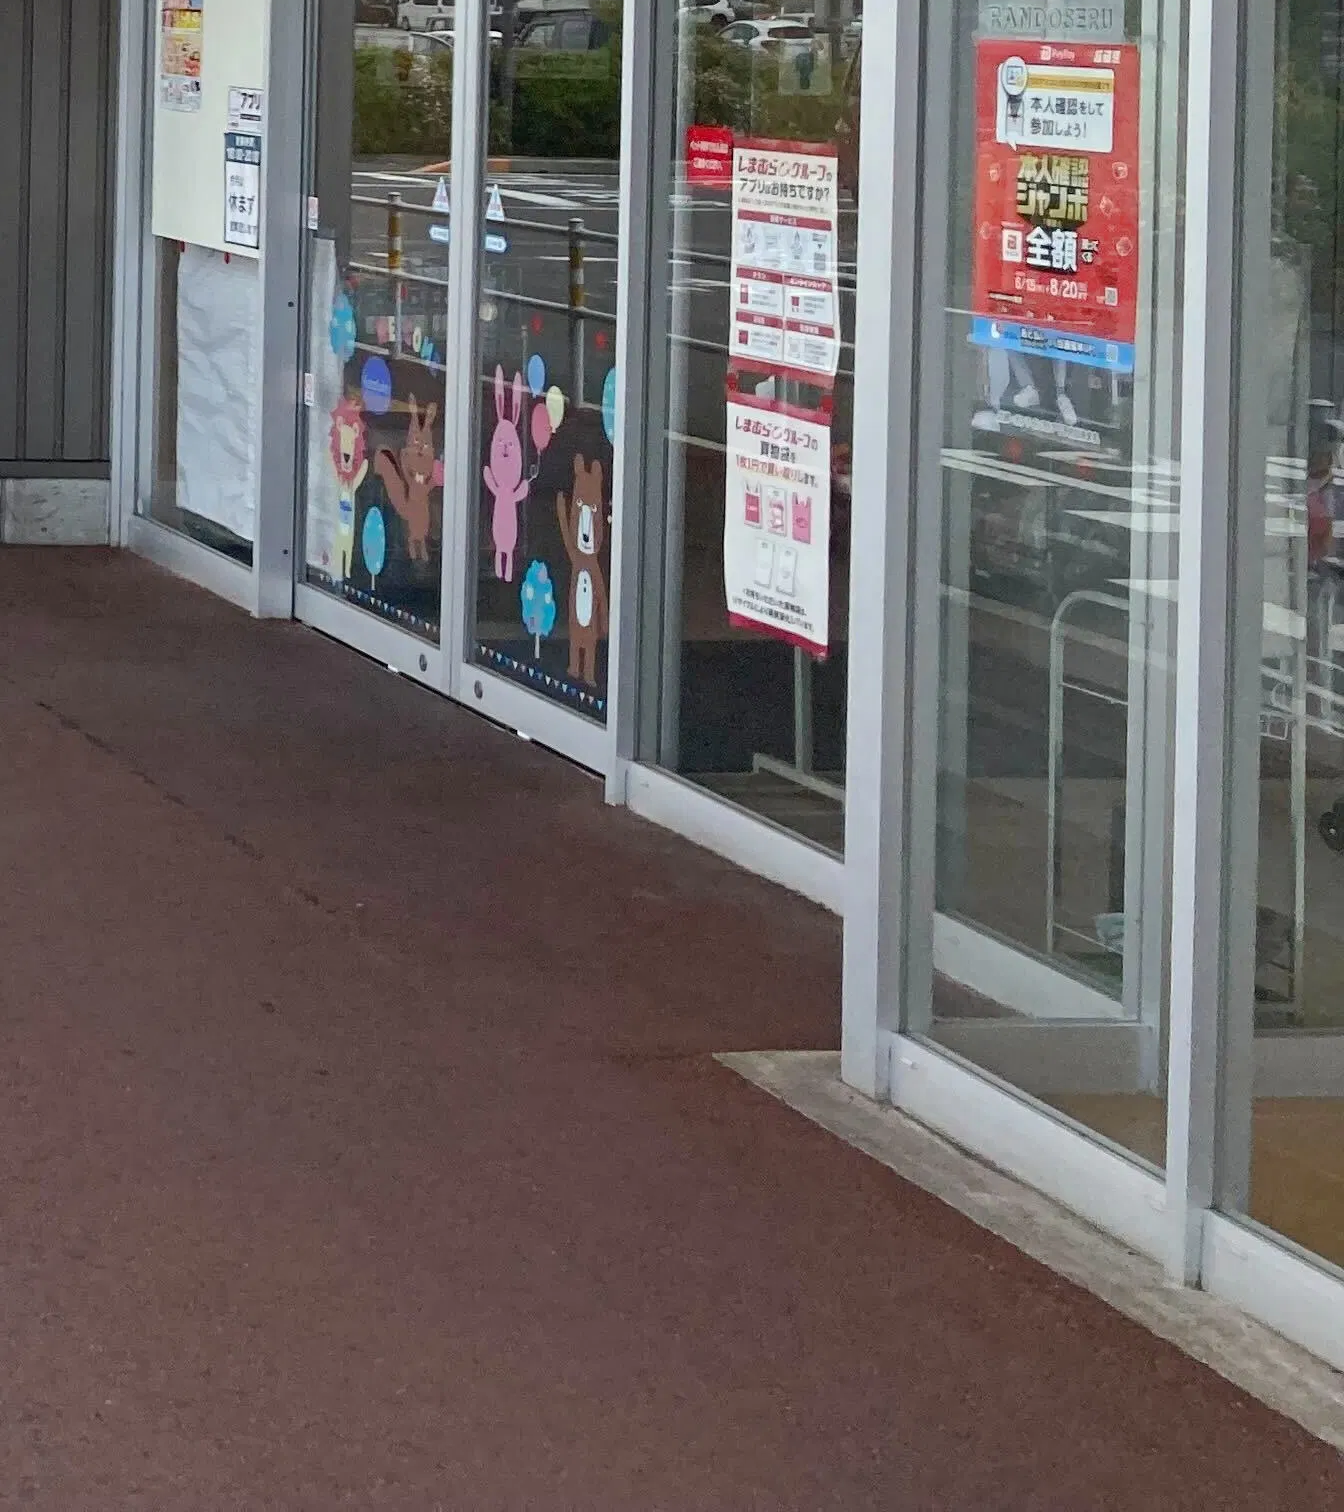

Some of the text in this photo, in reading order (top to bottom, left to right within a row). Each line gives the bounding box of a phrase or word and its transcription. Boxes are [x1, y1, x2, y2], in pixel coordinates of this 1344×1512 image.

[1030, 95, 1105, 117] 本人確認をして
[1018, 154, 1089, 187] 本人確認
[1016, 183, 1089, 221] ジャンボ
[1025, 226, 1078, 272] 全額
